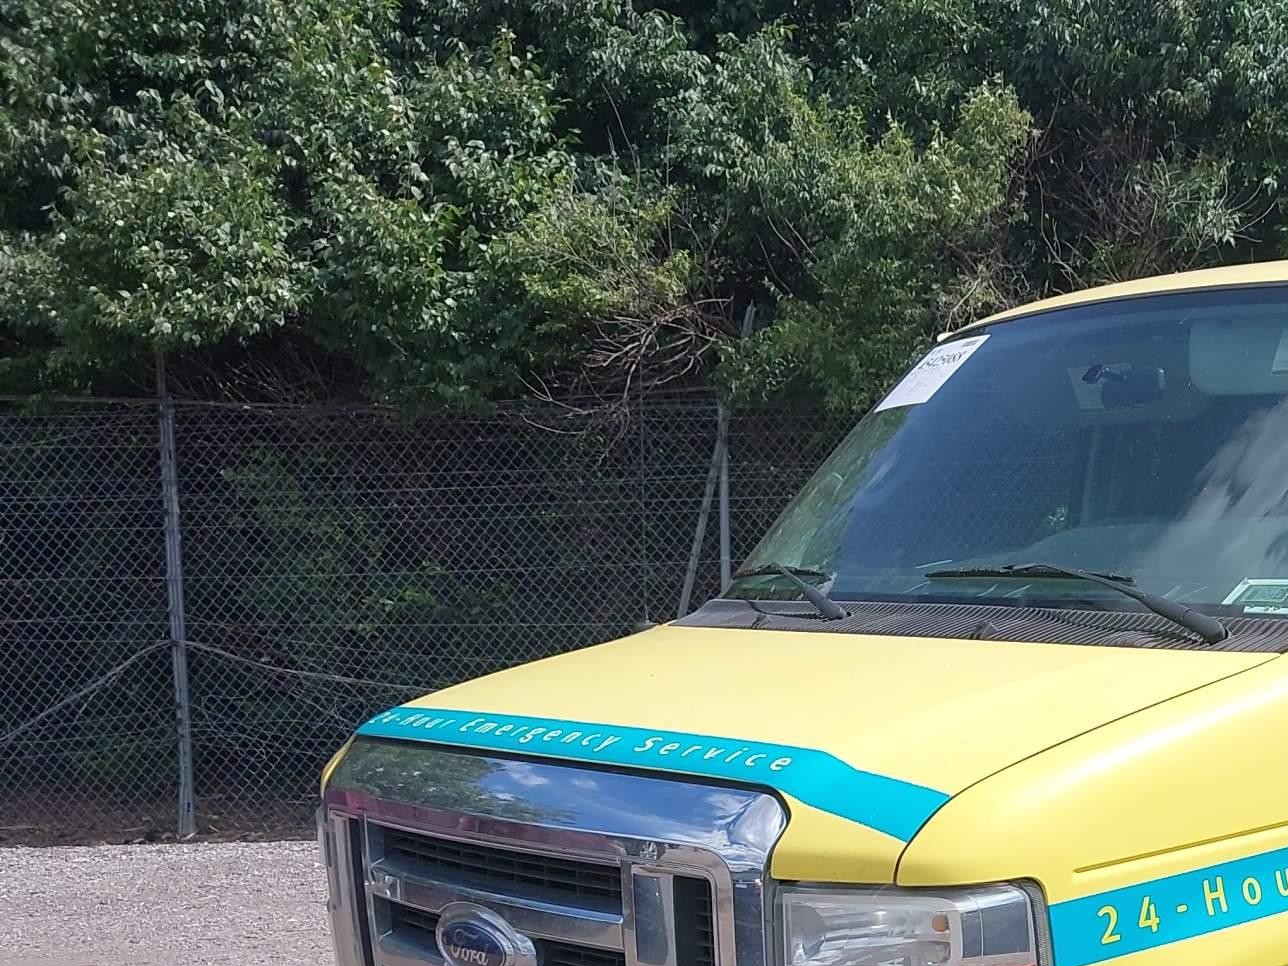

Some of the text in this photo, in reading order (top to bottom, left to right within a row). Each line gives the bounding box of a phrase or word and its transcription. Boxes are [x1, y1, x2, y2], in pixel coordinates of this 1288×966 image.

[459, 718, 621, 752] Emergency
[634, 736, 792, 771] Service
[444, 928, 489, 966] Ford
